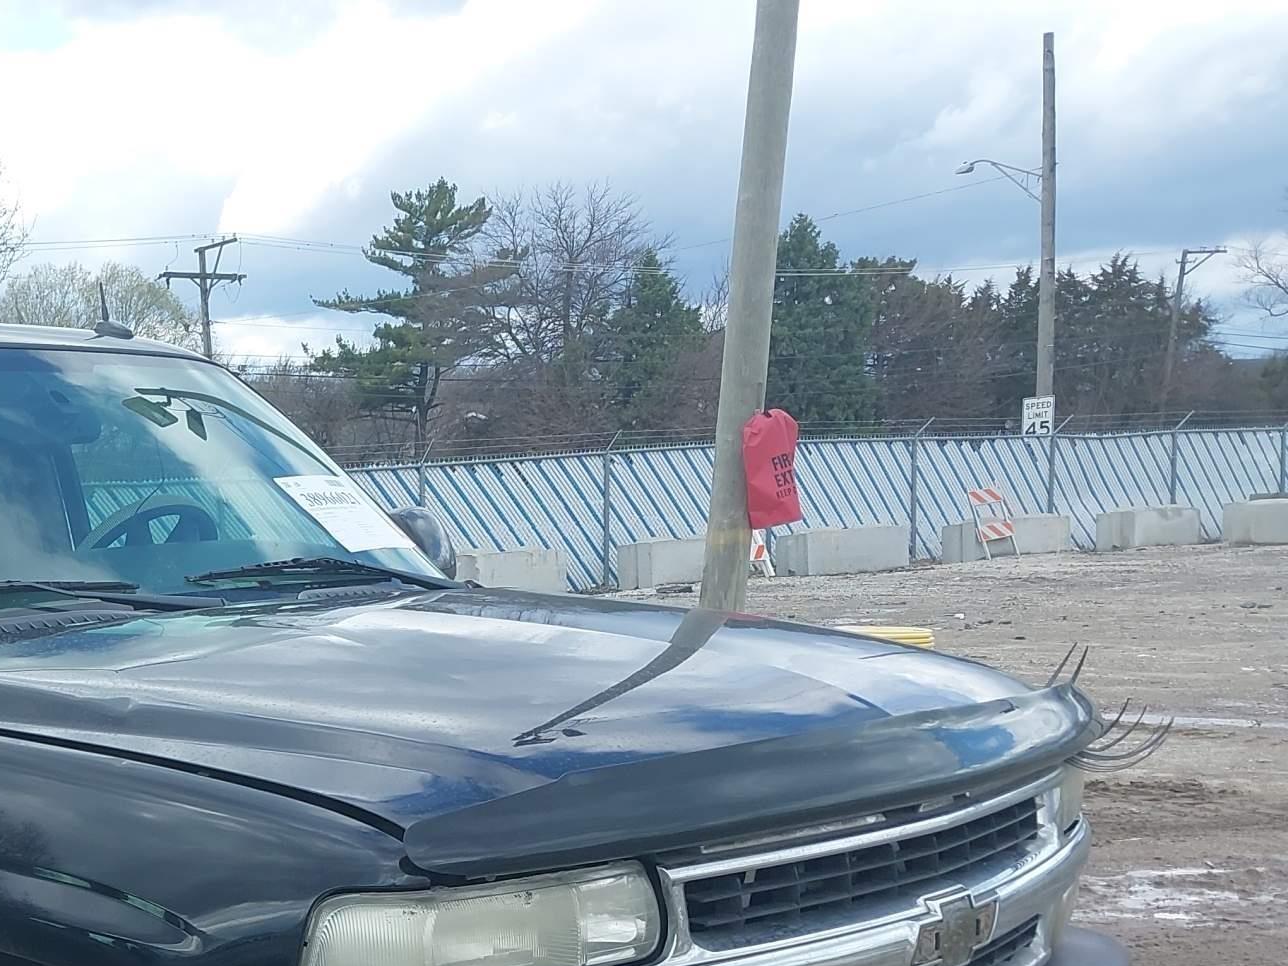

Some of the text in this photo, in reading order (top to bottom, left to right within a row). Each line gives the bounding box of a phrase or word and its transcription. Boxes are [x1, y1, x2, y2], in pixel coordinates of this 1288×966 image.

[1025, 401, 1052, 410] SPEED
[1027, 410, 1049, 420] LIMIT
[1025, 420, 1051, 435] 45
[771, 453, 792, 471] FIR
[775, 487, 792, 499] KEEP
